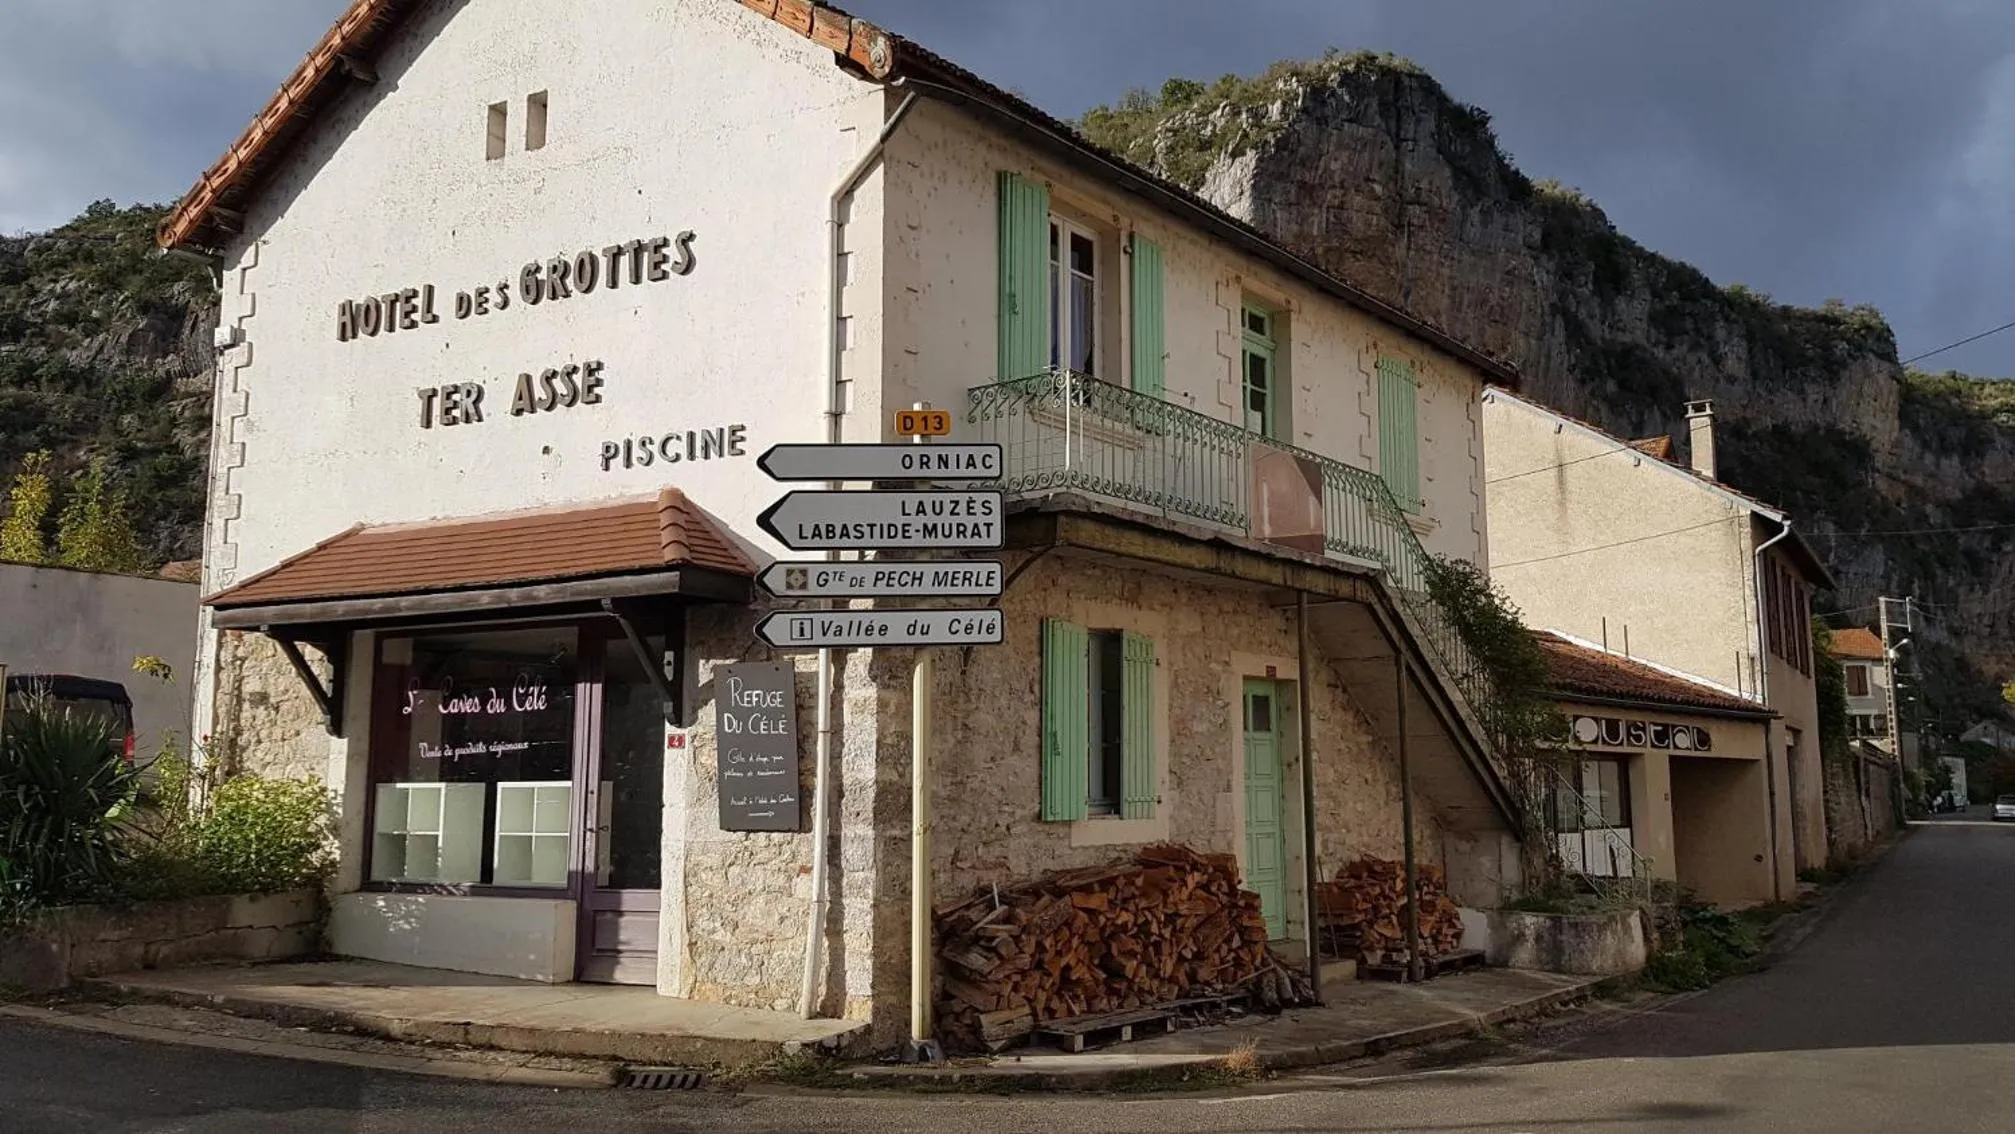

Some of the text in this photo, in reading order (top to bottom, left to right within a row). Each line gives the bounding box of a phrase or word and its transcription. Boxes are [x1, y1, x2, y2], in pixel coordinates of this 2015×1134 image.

[336, 230, 697, 342] HOTEL DES GROTTES
[600, 424, 746, 471] PISCINE
[901, 453, 994, 470] ORNIAC
[901, 497, 994, 517] LAUZÈS
[798, 522, 994, 540] LABASTIDE-MURAT
[850, 576, 866, 588] DE
[873, 571, 924, 587] PECH
[932, 570, 996, 587] MERLE
[821, 620, 889, 637] Vallée
[907, 619, 931, 636] du
[948, 617, 996, 635] Célé
[487, 687, 507, 714] du
[512, 674, 548, 712] Célé
[726, 676, 785, 708] REFUGE
